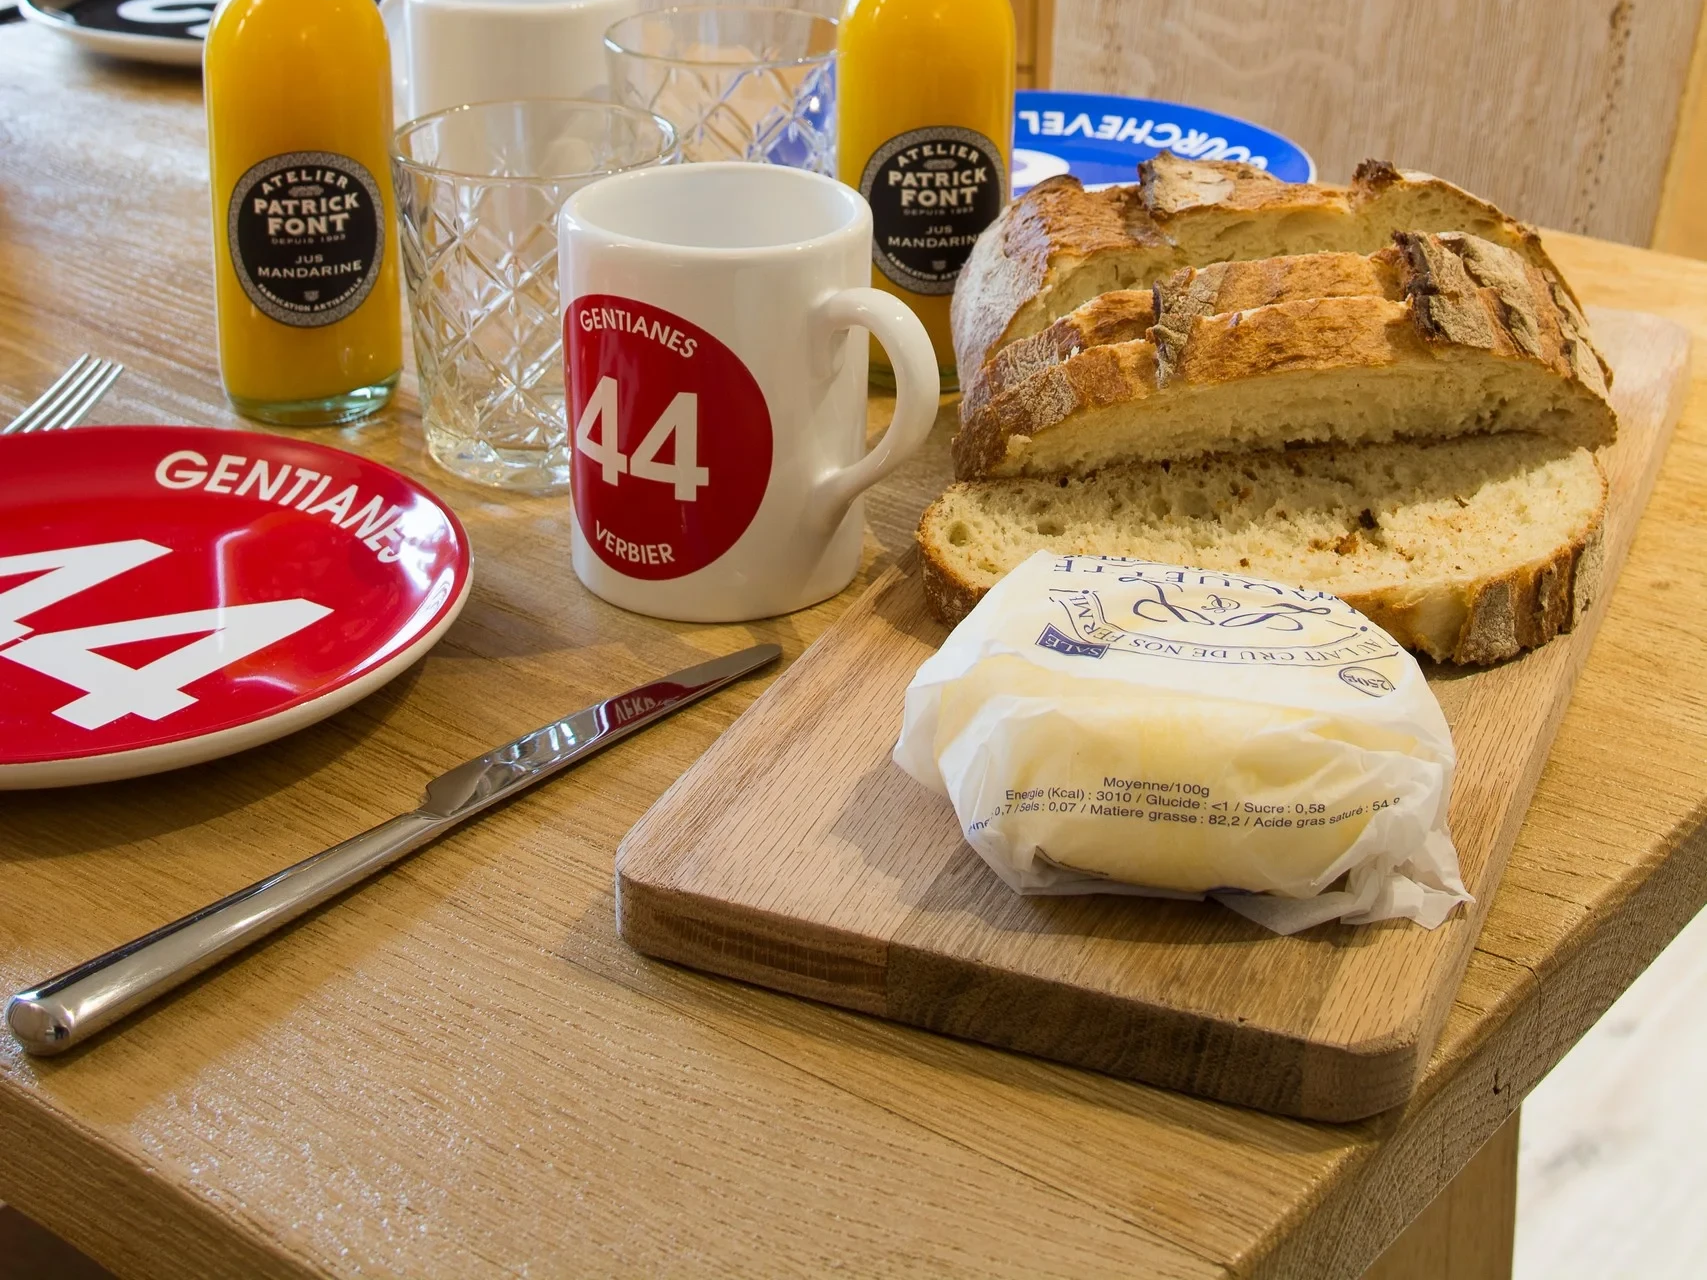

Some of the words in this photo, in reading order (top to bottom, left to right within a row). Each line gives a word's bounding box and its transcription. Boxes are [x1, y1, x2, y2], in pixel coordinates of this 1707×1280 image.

[897, 144, 980, 167] ATELIER
[261, 170, 348, 195] ATELIER
[888, 167, 988, 188] PATRICK
[254, 192, 360, 215] PATRICK
[901, 185, 978, 207] FONT
[268, 213, 350, 235] FONT
[925, 225, 953, 235] JUS
[271, 236, 314, 245] DEPUIS
[321, 233, 346, 243] 1993
[888, 234, 978, 248] MANDARIN
[257, 260, 362, 278] MANDARINE
[295, 254, 324, 264] JUS
[257, 283, 310, 311] FABRICATION
[314, 277, 363, 311] ARTISANALE
[579, 308, 698, 358] GENTIANES
[576, 375, 709, 502] 44
[596, 520, 676, 564] VERBIER
[1045, 634, 1102, 657] SALÉ
[1129, 638, 1183, 655] NOS
[1192, 647, 1227, 659] DE
[1240, 651, 1294, 661] CRU
[1305, 646, 1359, 662] LAIT
[1362, 638, 1384, 654] AU
[1343, 673, 1390, 692] 250g
[1103, 777, 1210, 798] Moyenne/100g
[1005, 788, 1044, 801] Energie
[1048, 787, 1085, 801] (Kcal)
[1096, 790, 1132, 803] 3010
[1145, 793, 1200, 809] Glucide
[1212, 801, 1228, 812] <1
[1244, 802, 1285, 814] Sucre
[1295, 803, 1326, 815] 0,58
[1049, 802, 1076, 813] 0,07
[1090, 804, 1144, 818] Matiere
[1148, 810, 1197, 823] grasse
[1208, 814, 1240, 827] 82,2
[1253, 817, 1292, 827] Acide
[1296, 817, 1326, 828] gras
[1329, 805, 1363, 825] saturé
[1372, 799, 1389, 811] 54
